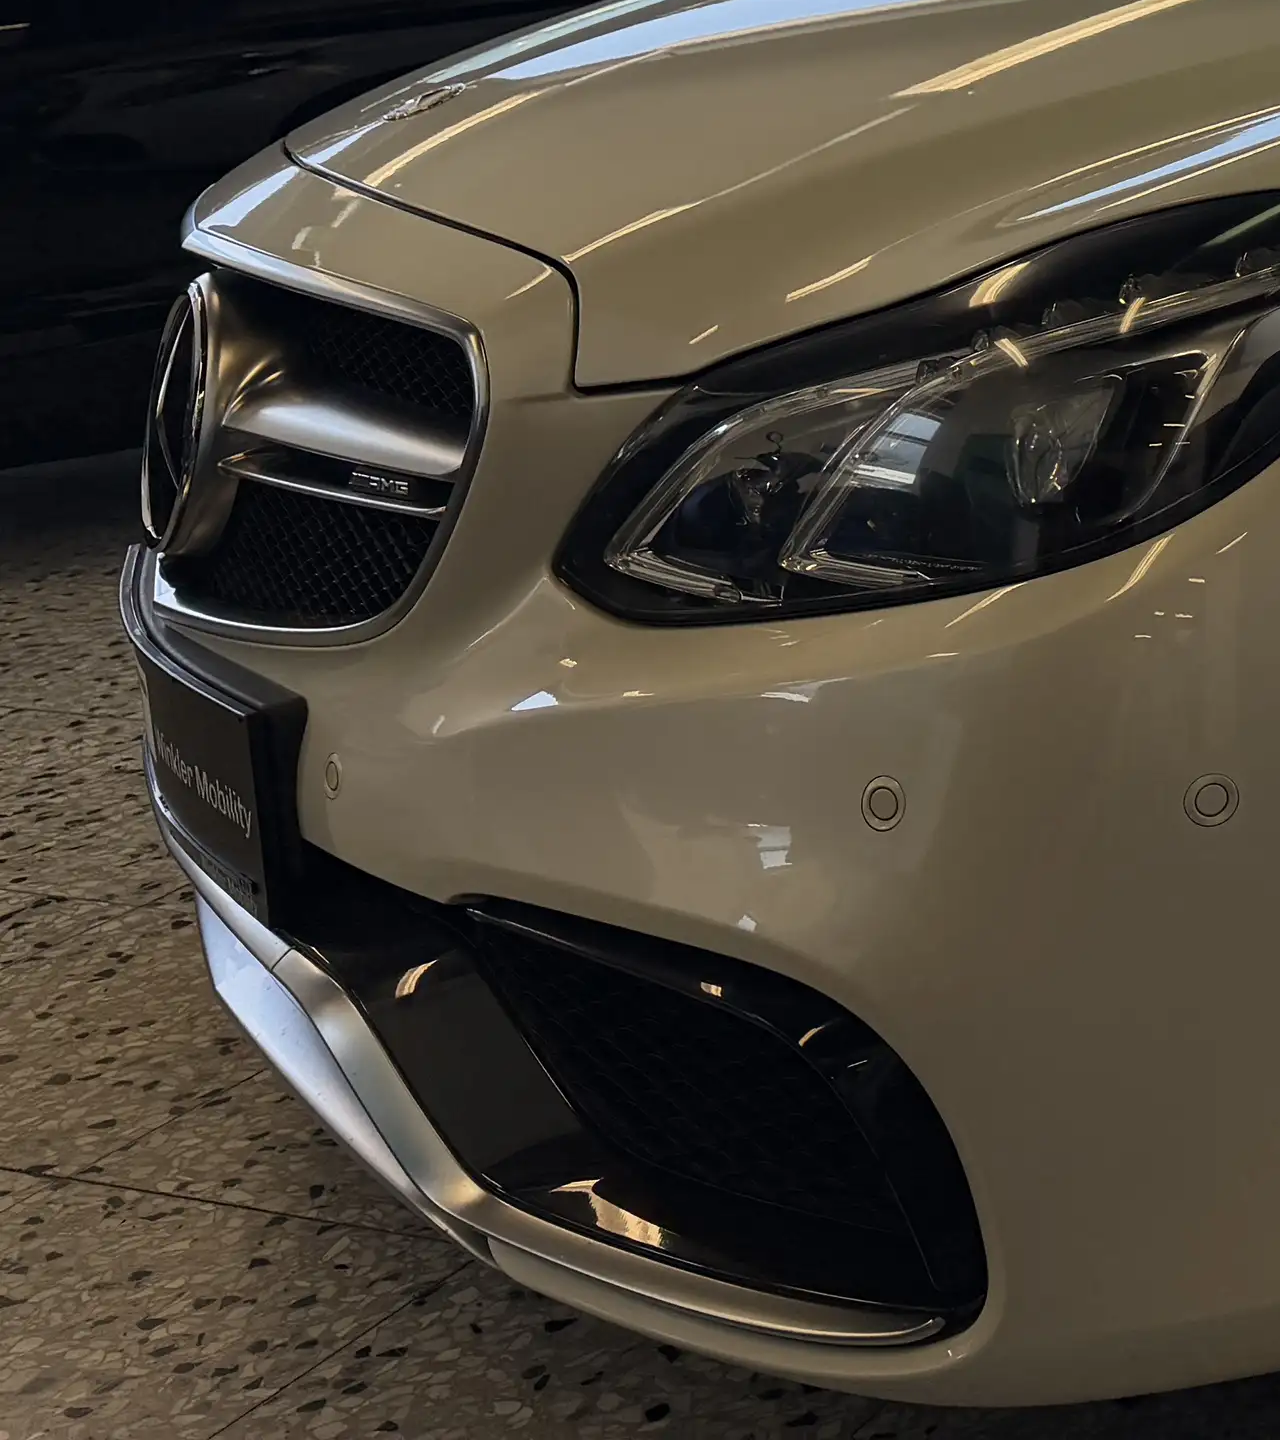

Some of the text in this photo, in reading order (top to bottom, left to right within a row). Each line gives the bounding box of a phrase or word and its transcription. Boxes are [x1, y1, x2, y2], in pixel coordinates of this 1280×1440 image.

[369, 475, 409, 496] AMG
[155, 727, 253, 840] Winkler Mobility
